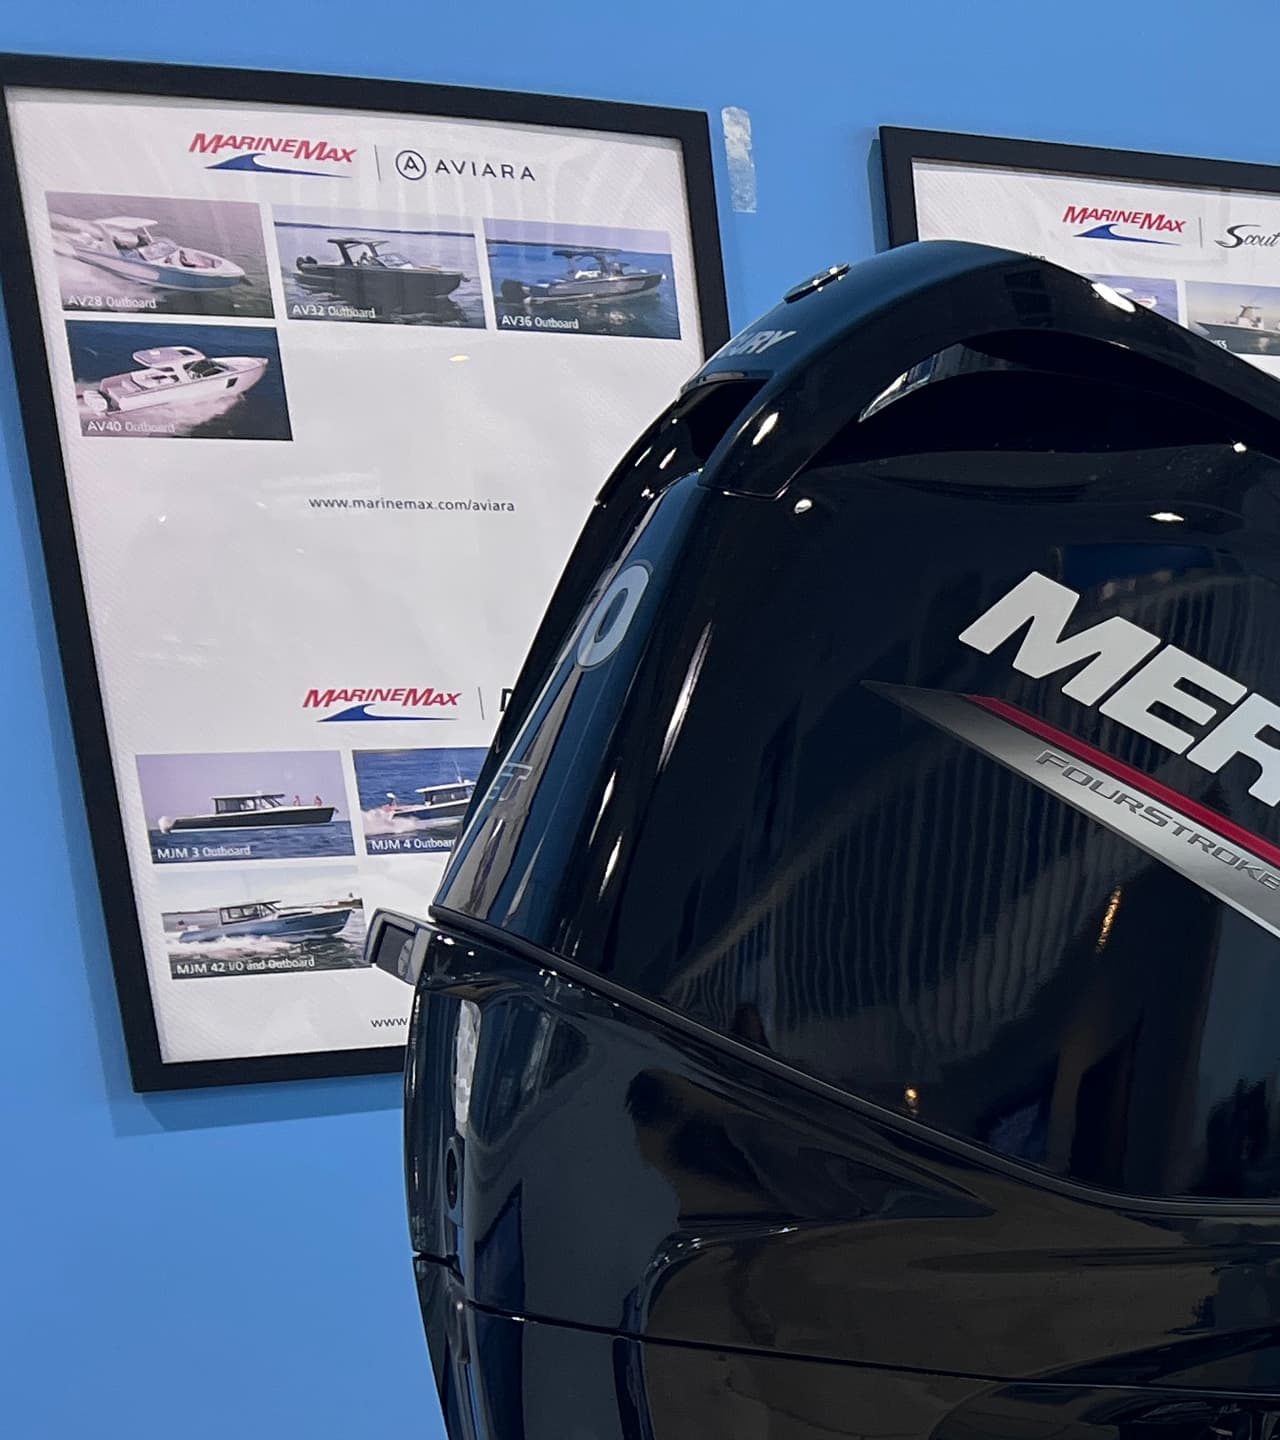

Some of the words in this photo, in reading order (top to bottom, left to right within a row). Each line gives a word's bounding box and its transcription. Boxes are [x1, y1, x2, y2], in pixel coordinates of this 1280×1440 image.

[434, 159, 537, 182] AVIARA
[68, 295, 103, 307] AV28
[105, 296, 157, 309] Outboard
[292, 303, 325, 316] AV32
[327, 305, 375, 319] Outboard
[501, 316, 532, 327] AV36
[534, 317, 579, 330] Outboard
[87, 420, 122, 433] AV40
[124, 421, 175, 434] Outboard
[308, 498, 516, 513] www.marinemax.com/aviara
[371, 839, 400, 851] MJM
[404, 839, 411, 848] 4
[414, 837, 457, 849] Outboar
[157, 847, 189, 859] MJM
[191, 847, 199, 858] 3
[202, 845, 251, 857] Outboard
[176, 962, 207, 975] MJM
[210, 962, 226, 973] 42
[246, 959, 265, 970] and
[267, 956, 315, 969] Outboard
